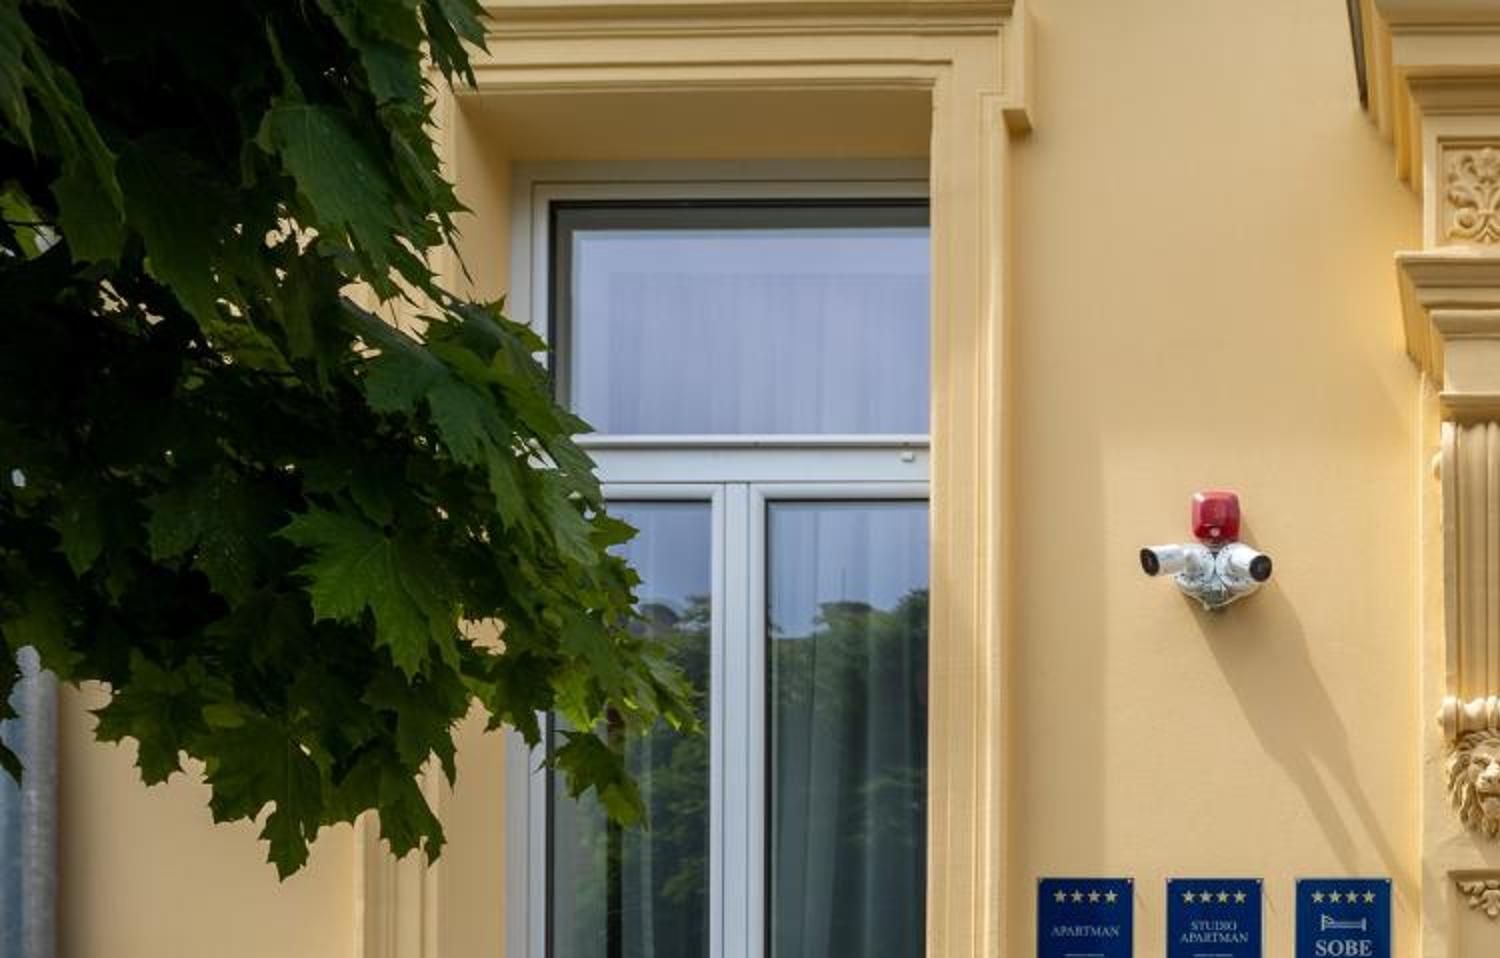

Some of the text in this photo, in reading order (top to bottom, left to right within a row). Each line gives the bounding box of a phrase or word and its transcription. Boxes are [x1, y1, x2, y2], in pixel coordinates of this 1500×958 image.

[1051, 924, 1121, 937] APARTMAN
[1190, 919, 1238, 931] STUDIO
[1180, 931, 1249, 943] APARTMAN
[1314, 938, 1373, 957] SOBE
